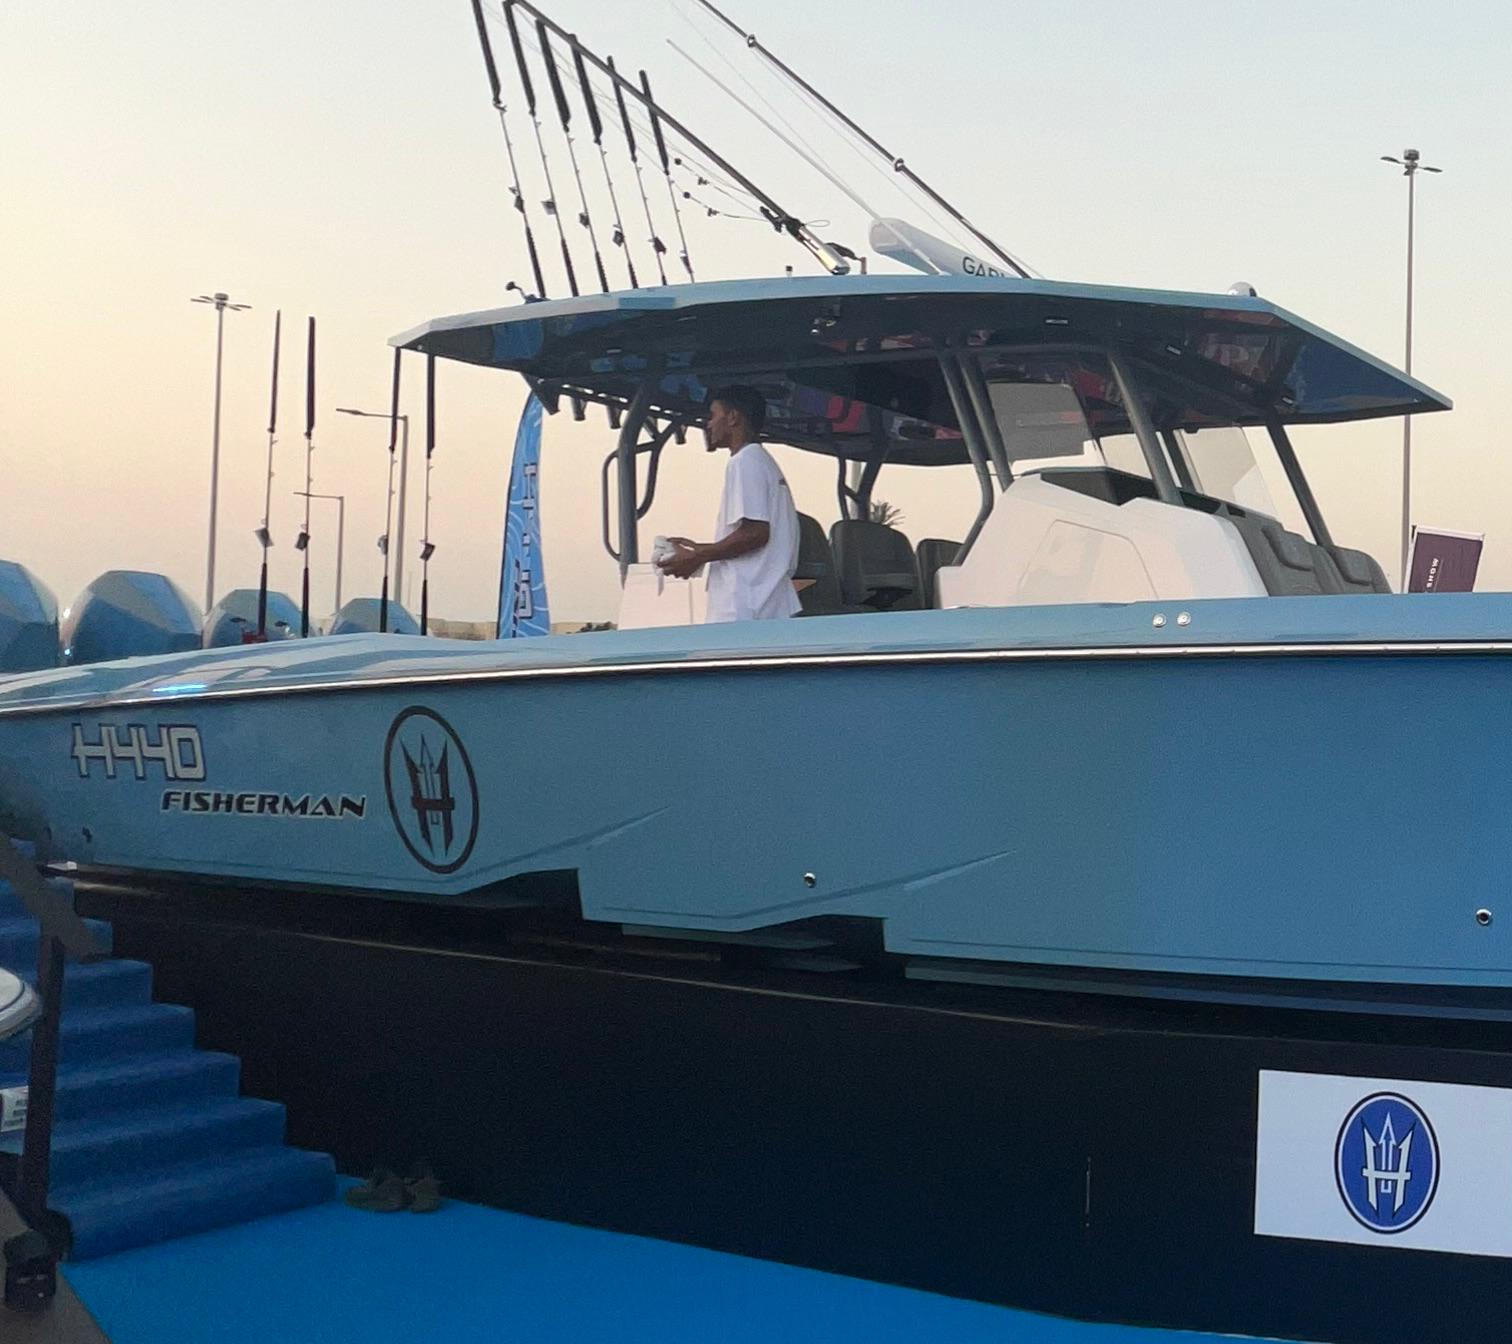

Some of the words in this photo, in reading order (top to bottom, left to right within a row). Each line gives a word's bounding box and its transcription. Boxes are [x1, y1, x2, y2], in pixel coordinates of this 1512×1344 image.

[962, 256, 1005, 277] GAR
[72, 723, 206, 781] H440
[161, 790, 366, 818] FISHERMAN
